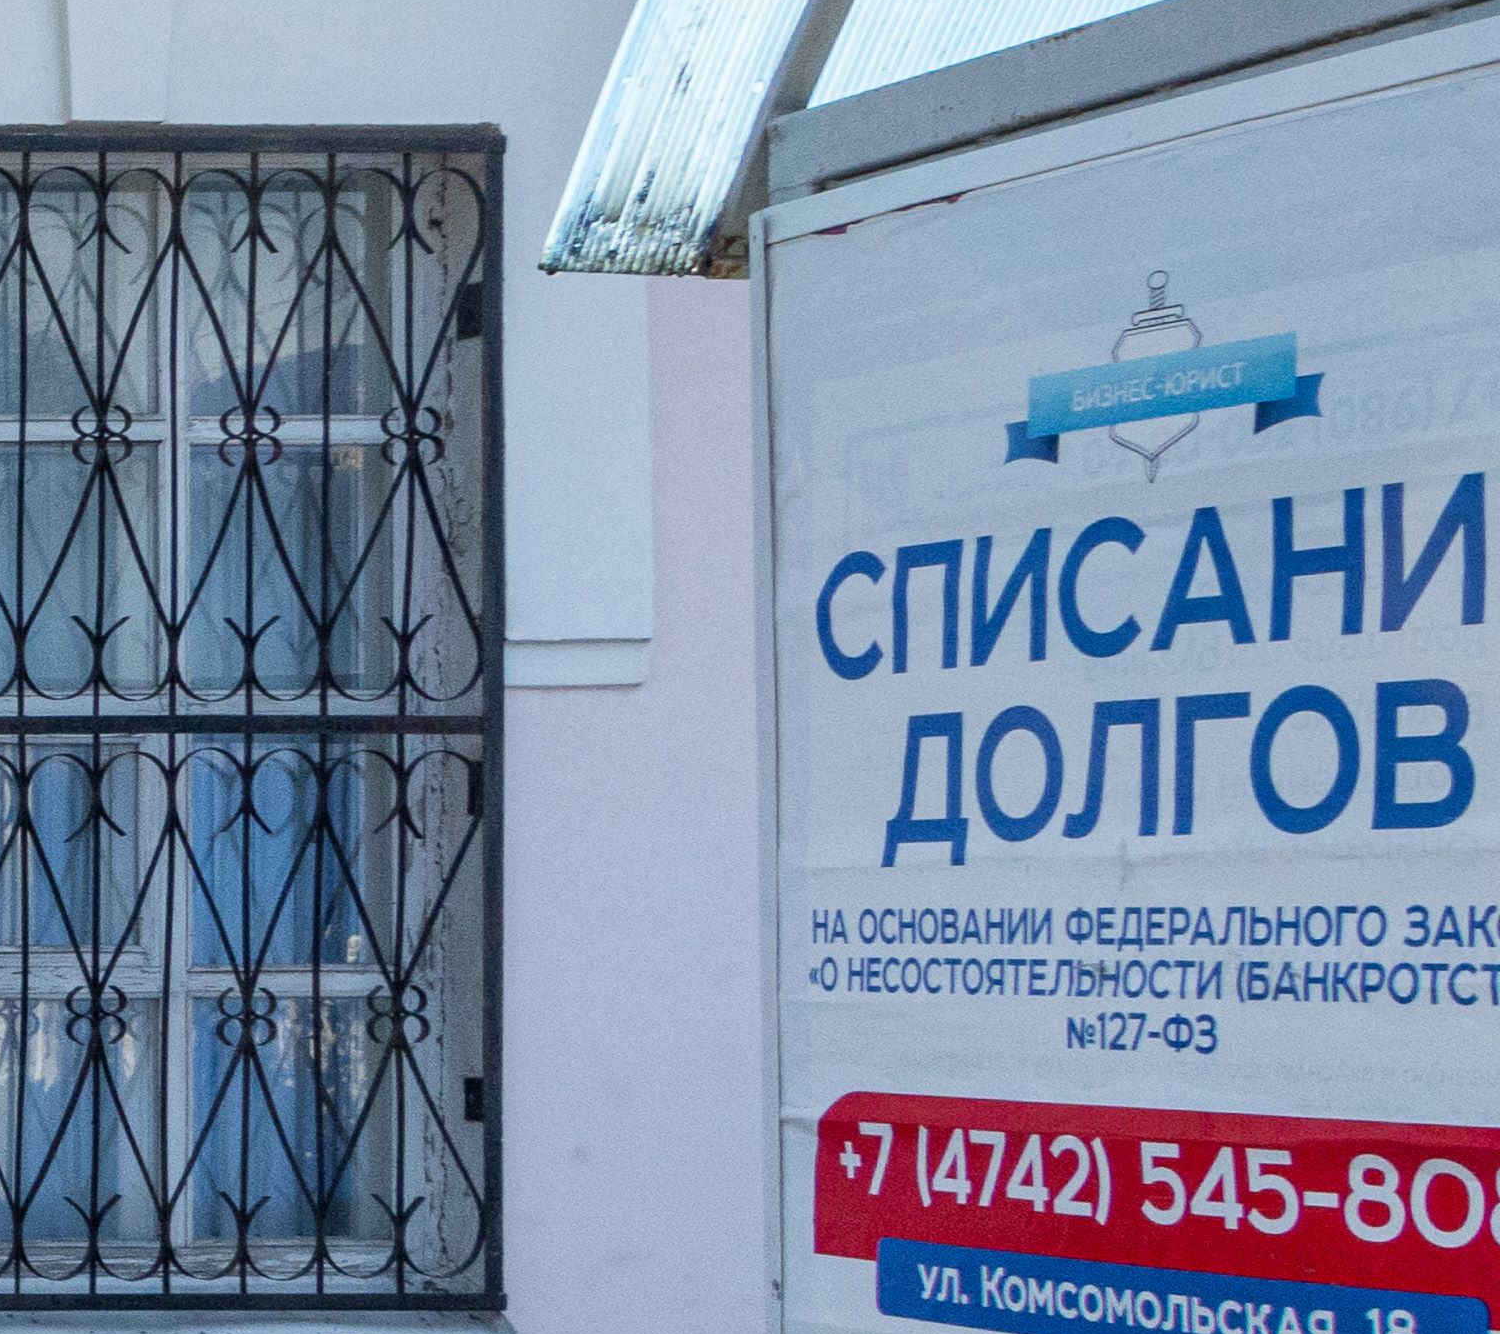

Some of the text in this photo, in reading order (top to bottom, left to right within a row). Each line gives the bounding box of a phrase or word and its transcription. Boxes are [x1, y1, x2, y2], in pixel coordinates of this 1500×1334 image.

[1071, 361, 1249, 412] БИЗНЕС-ЮРИСТ
[816, 472, 1486, 680] СПИСАНИ
[881, 678, 1476, 867] ДОЛГОВ
[812, 904, 1500, 952] НА ОСНОВАНИИ ФЕДЕРАЛЬНОГО ЗАК
[848, 957, 1223, 1000] НЕСОСТОЯТЕЛЬНОСТИ
[1066, 1012, 1218, 1055] №127-ФЗ
[840, 1121, 1500, 1249] +7 (4742) 545-80
